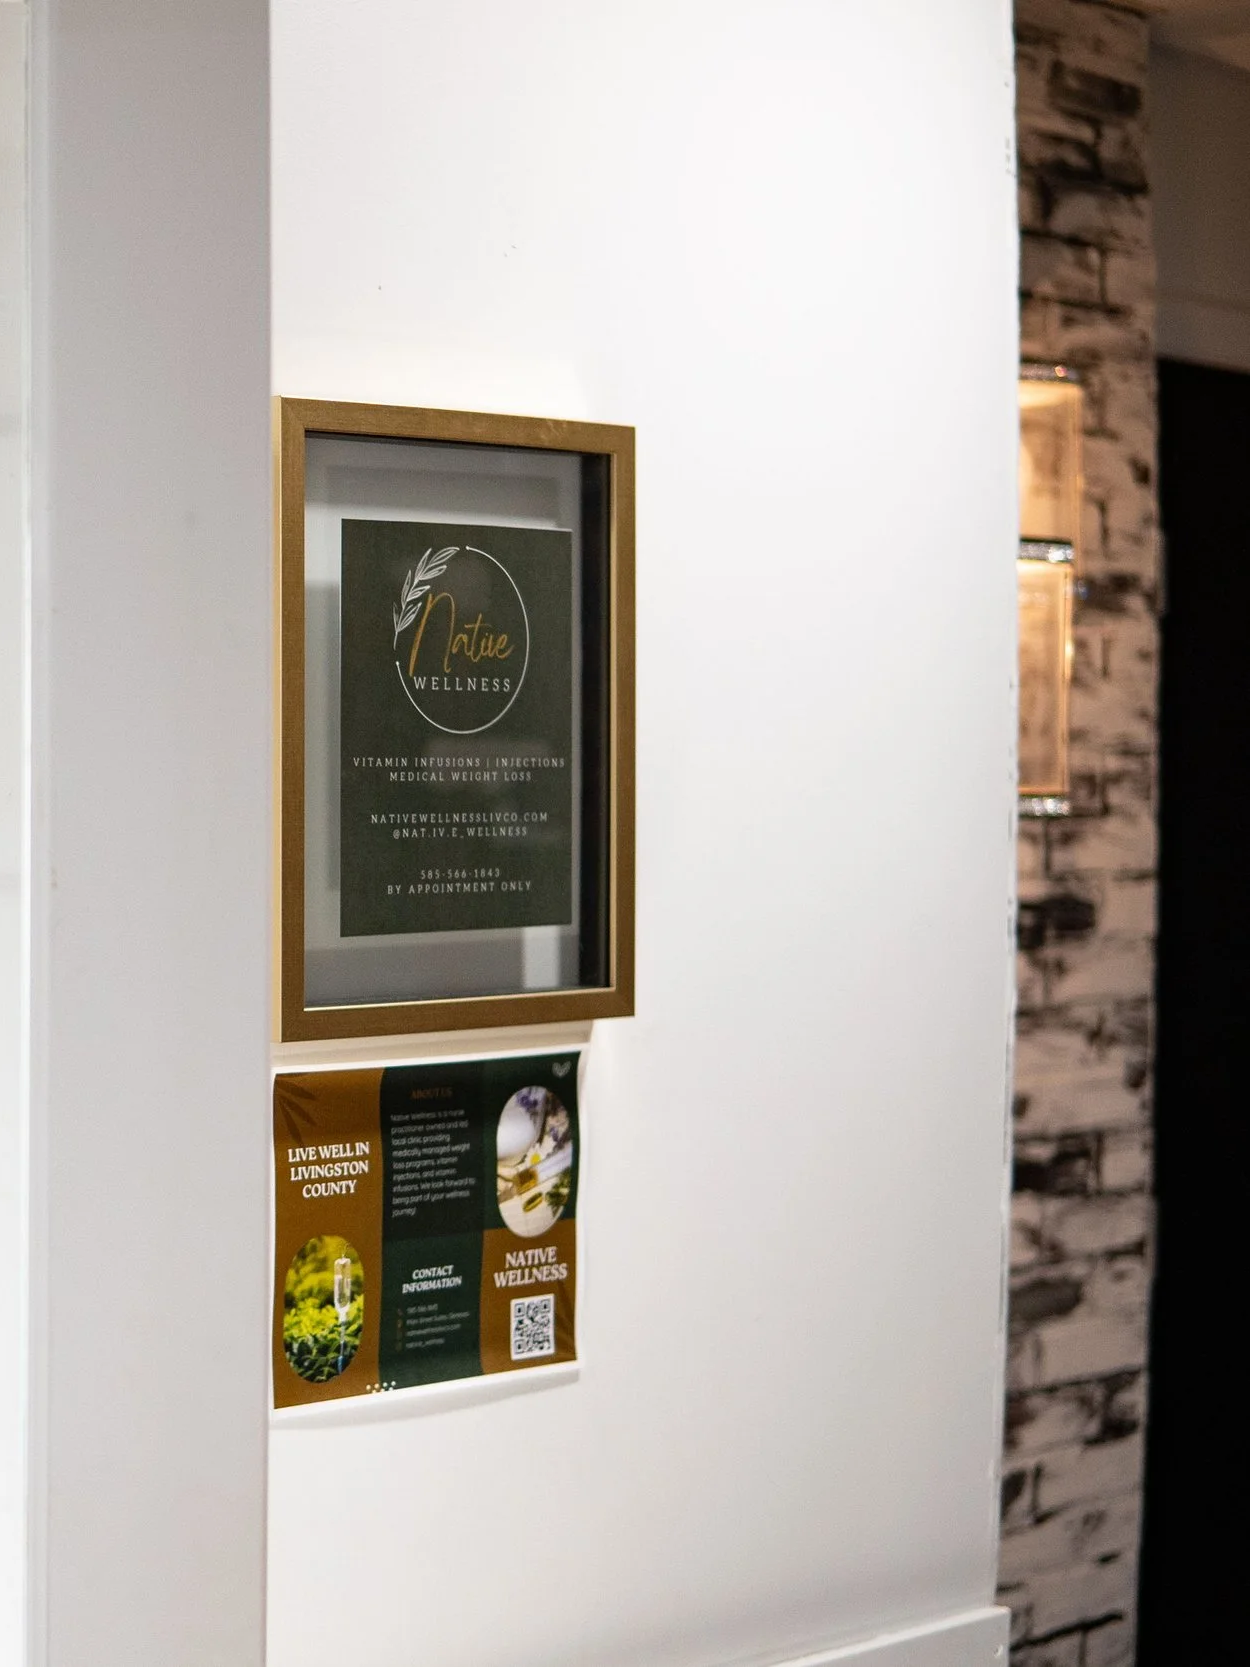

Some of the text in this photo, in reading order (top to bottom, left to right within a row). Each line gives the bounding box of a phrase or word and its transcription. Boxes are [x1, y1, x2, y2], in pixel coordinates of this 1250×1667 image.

[414, 677, 511, 692] WELLNESS
[353, 757, 408, 767] VITAMIN
[414, 757, 481, 767] INFUSIONS
[495, 757, 565, 768] INJECTIONS
[389, 771, 532, 781] MEDICAL WEIGHT LOSS
[371, 812, 548, 824] NATIVEWELLNESSLIVCO.COM
[392, 826, 527, 840] @NAT.IV.E_WELLNESS
[387, 881, 531, 895] BY APPOINTMENT ONLY
[288, 1141, 370, 1162] LIVE WELL IN
[290, 1160, 369, 1181] LIVINGSTON
[302, 1180, 357, 1198] COUNTY
[505, 1246, 557, 1268] NATIVE
[412, 1265, 454, 1280] CONTACT
[494, 1263, 568, 1289] WELLNESS
[402, 1276, 462, 1294] INFORMATION
